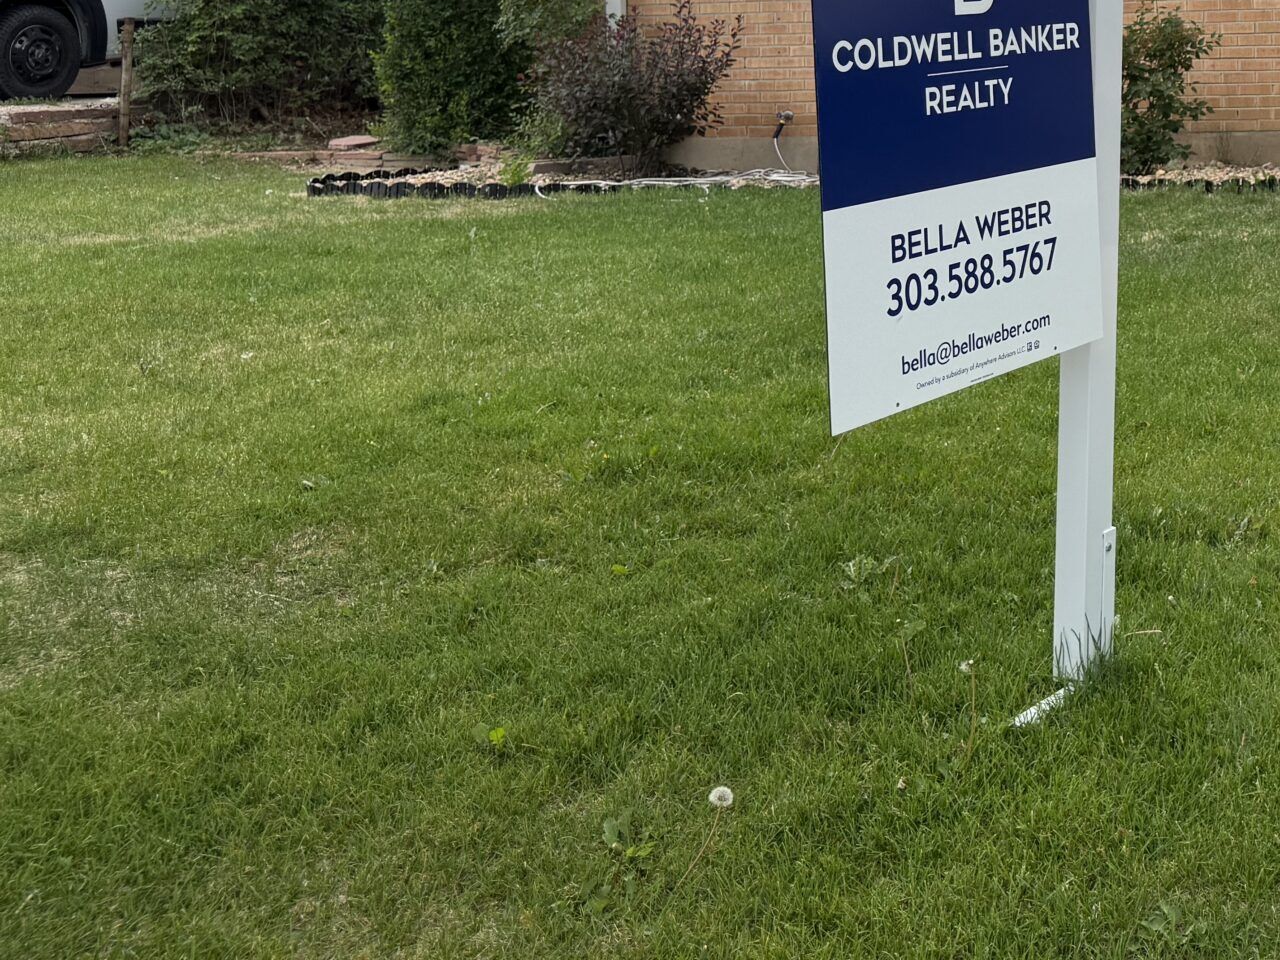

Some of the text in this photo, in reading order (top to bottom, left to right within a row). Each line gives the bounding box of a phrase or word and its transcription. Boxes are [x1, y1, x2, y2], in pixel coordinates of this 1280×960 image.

[832, 22, 1080, 72] COLDWELL BANKER
[925, 77, 1013, 116] REALTY
[890, 200, 1052, 264] BELLA WEBER
[886, 236, 1058, 317] 303.588.5767
[901, 313, 1051, 375] bella@bellaweber.com
